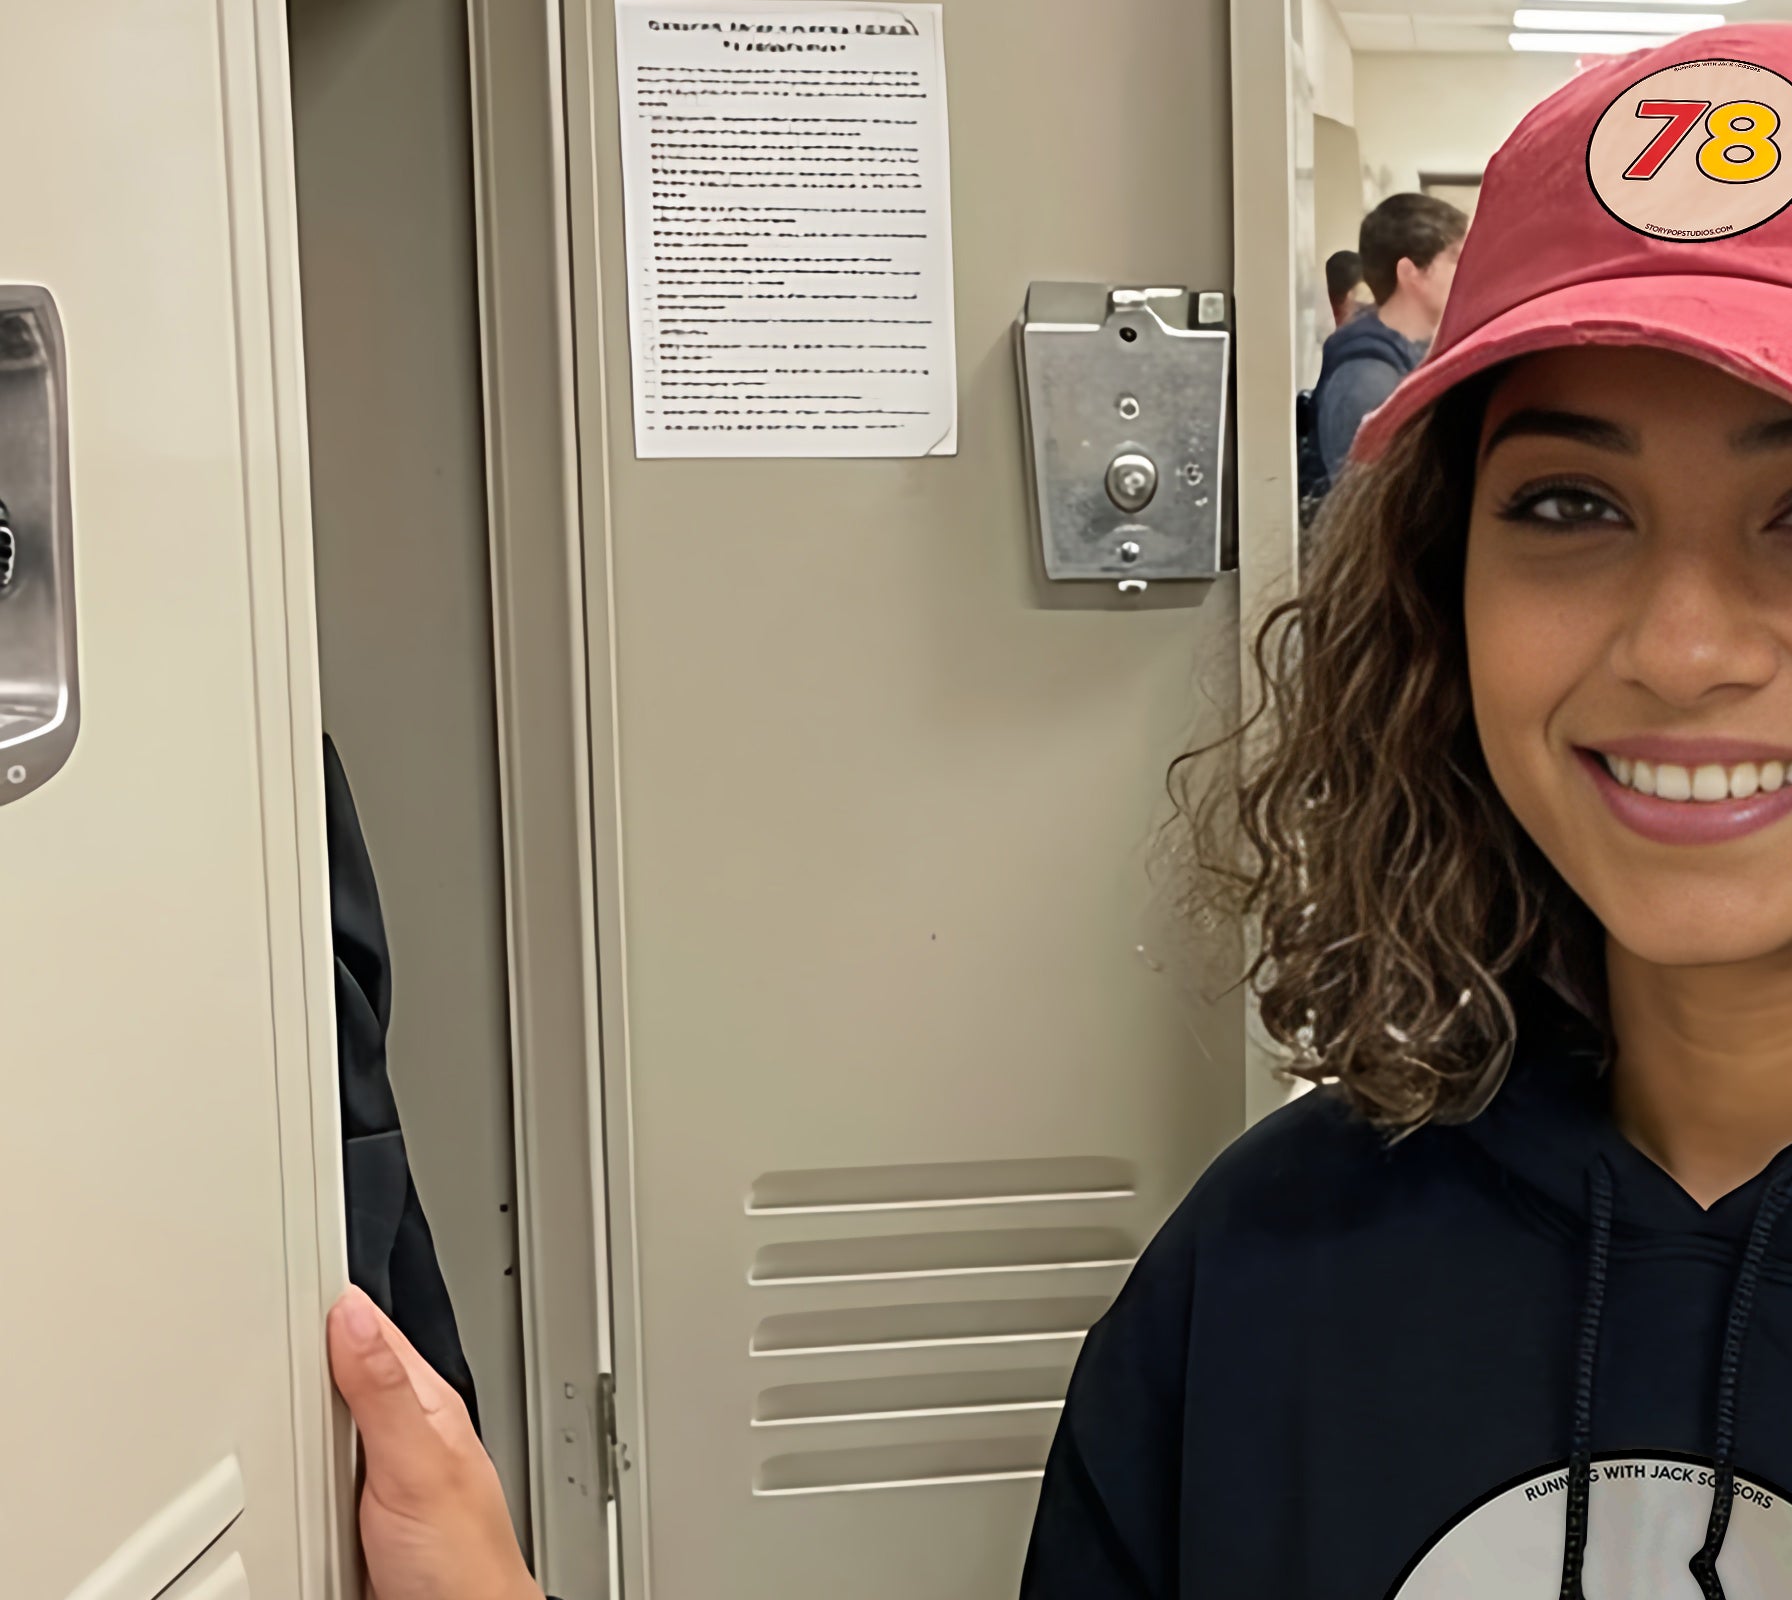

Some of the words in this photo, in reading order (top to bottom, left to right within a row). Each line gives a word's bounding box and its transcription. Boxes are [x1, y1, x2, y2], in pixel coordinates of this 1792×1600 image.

[1622, 100, 1781, 184] 78
[1644, 223, 1734, 237] STORYPOPSTUDIOS.COM
[1525, 1469, 1599, 1501] RUNNG
[1603, 1465, 1645, 1479] WITH
[1650, 1465, 1694, 1483] JACK
[1697, 1472, 1773, 1509] SCSORS
